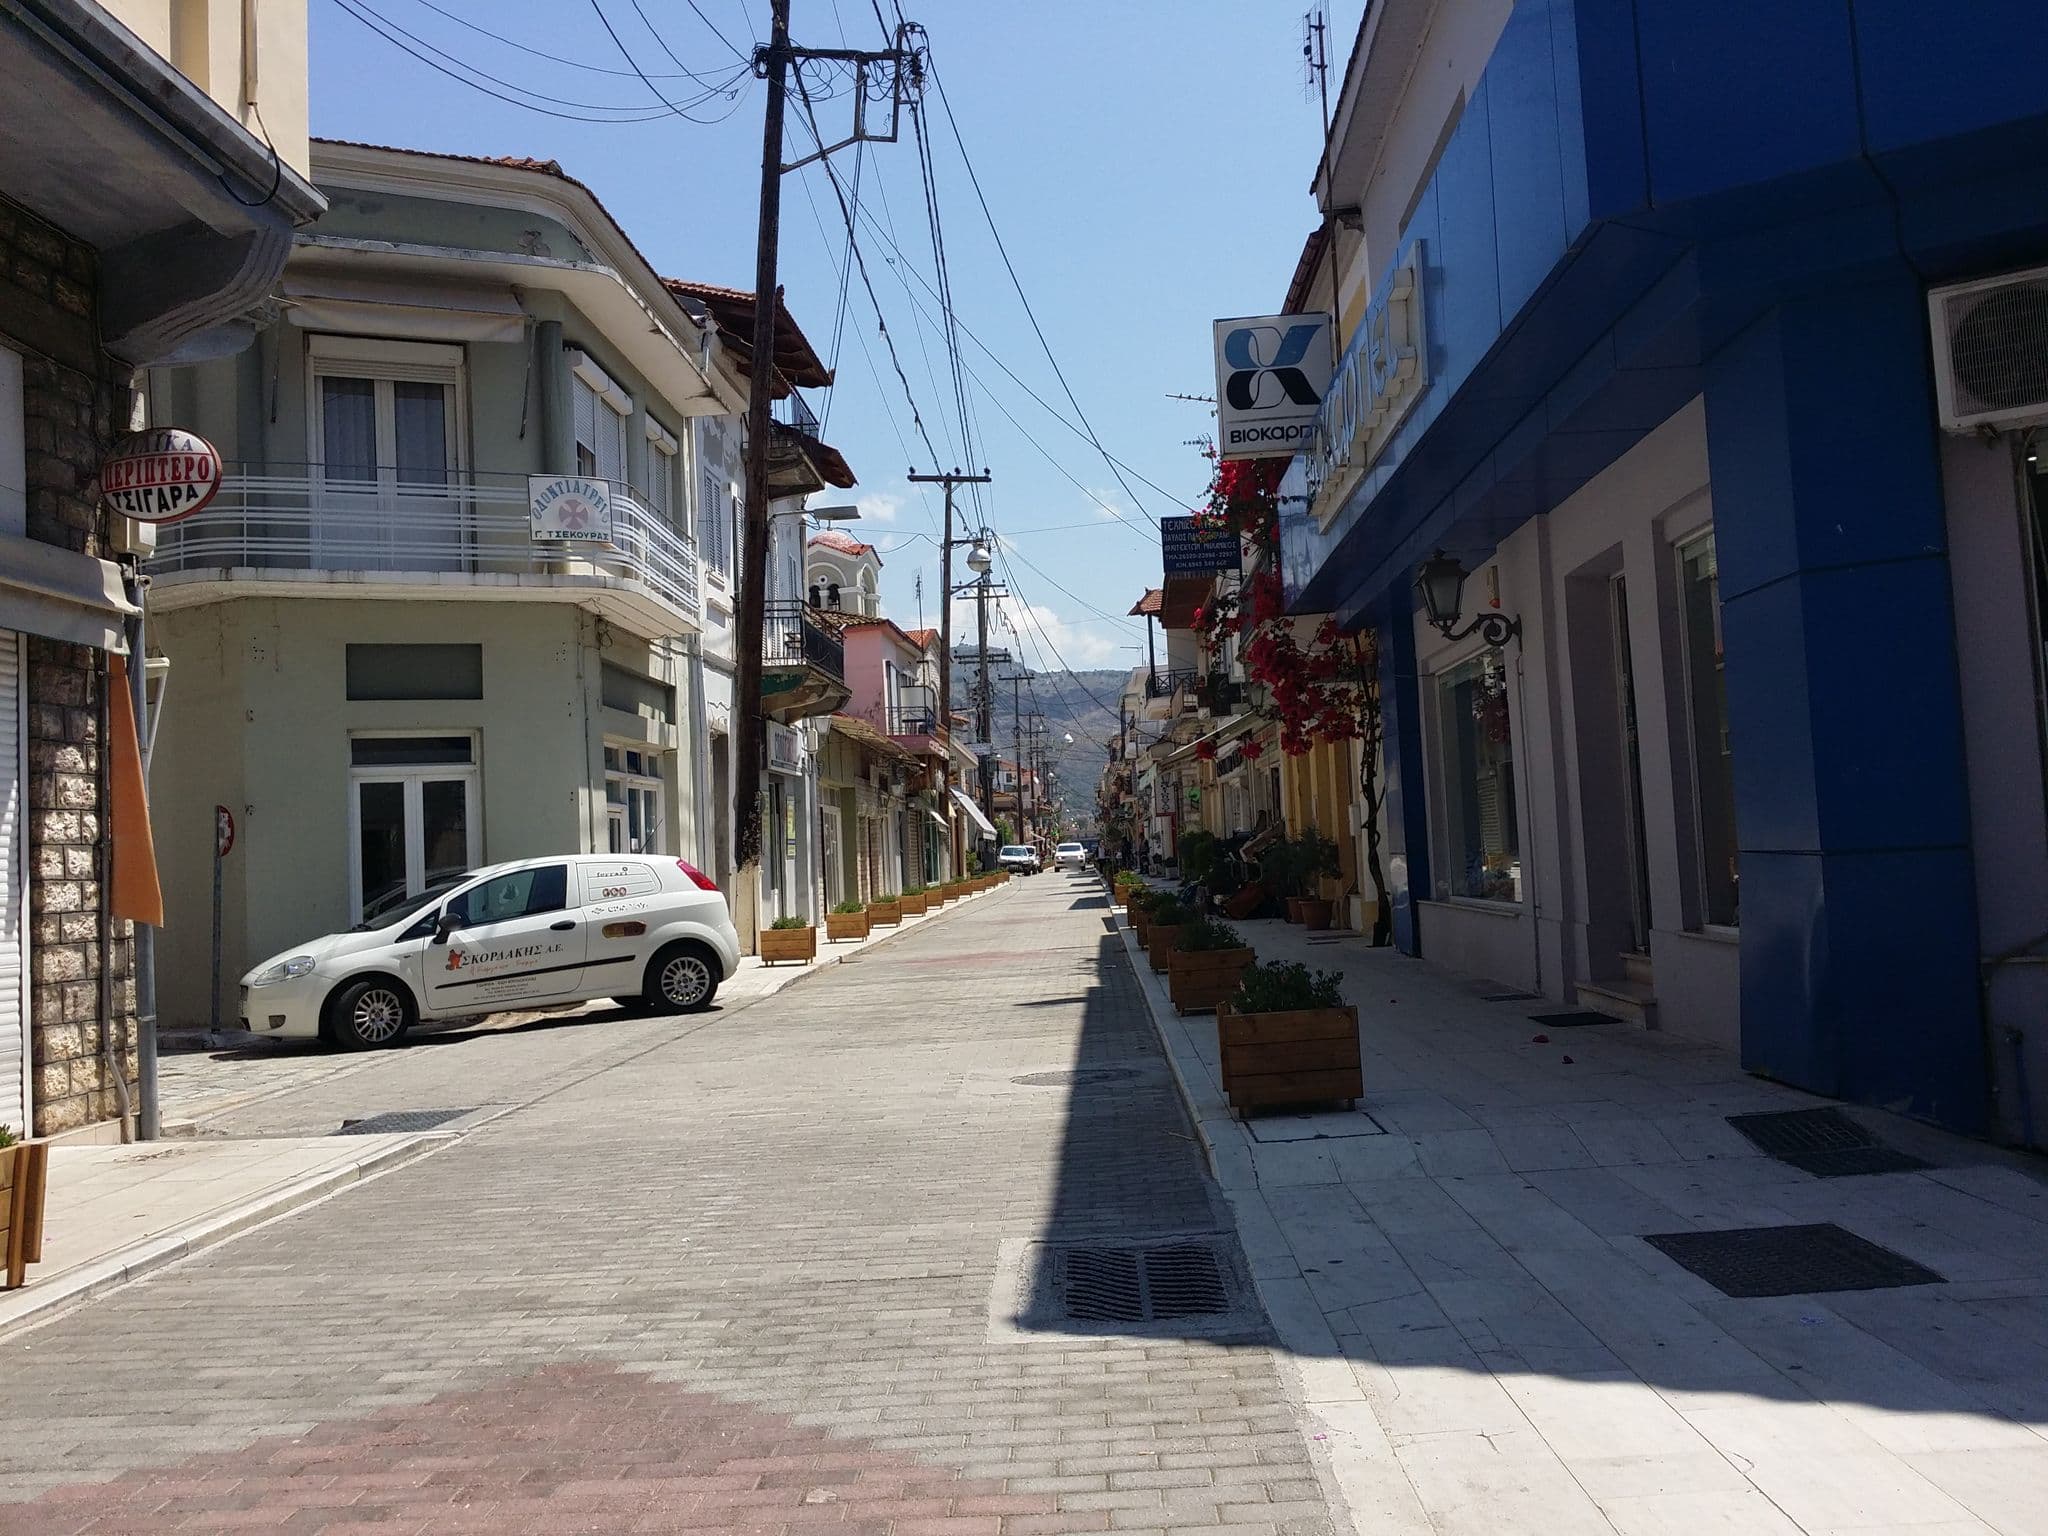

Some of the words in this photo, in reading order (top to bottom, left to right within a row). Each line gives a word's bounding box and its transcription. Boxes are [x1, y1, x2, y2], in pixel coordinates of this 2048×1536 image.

[105, 456, 210, 490] ΠΕΡΙΠΤΕΡΟ
[112, 484, 199, 513] ΤΣΙΓΑΡΑ
[532, 480, 610, 523] ΟΔΟΝΤΙΑΤΡΕΙΟ
[547, 530, 609, 540] ΤΣΕΚΟΥΡΑΣ
[462, 944, 543, 966] ΣΚΟΡΔΑΚΗΣ
